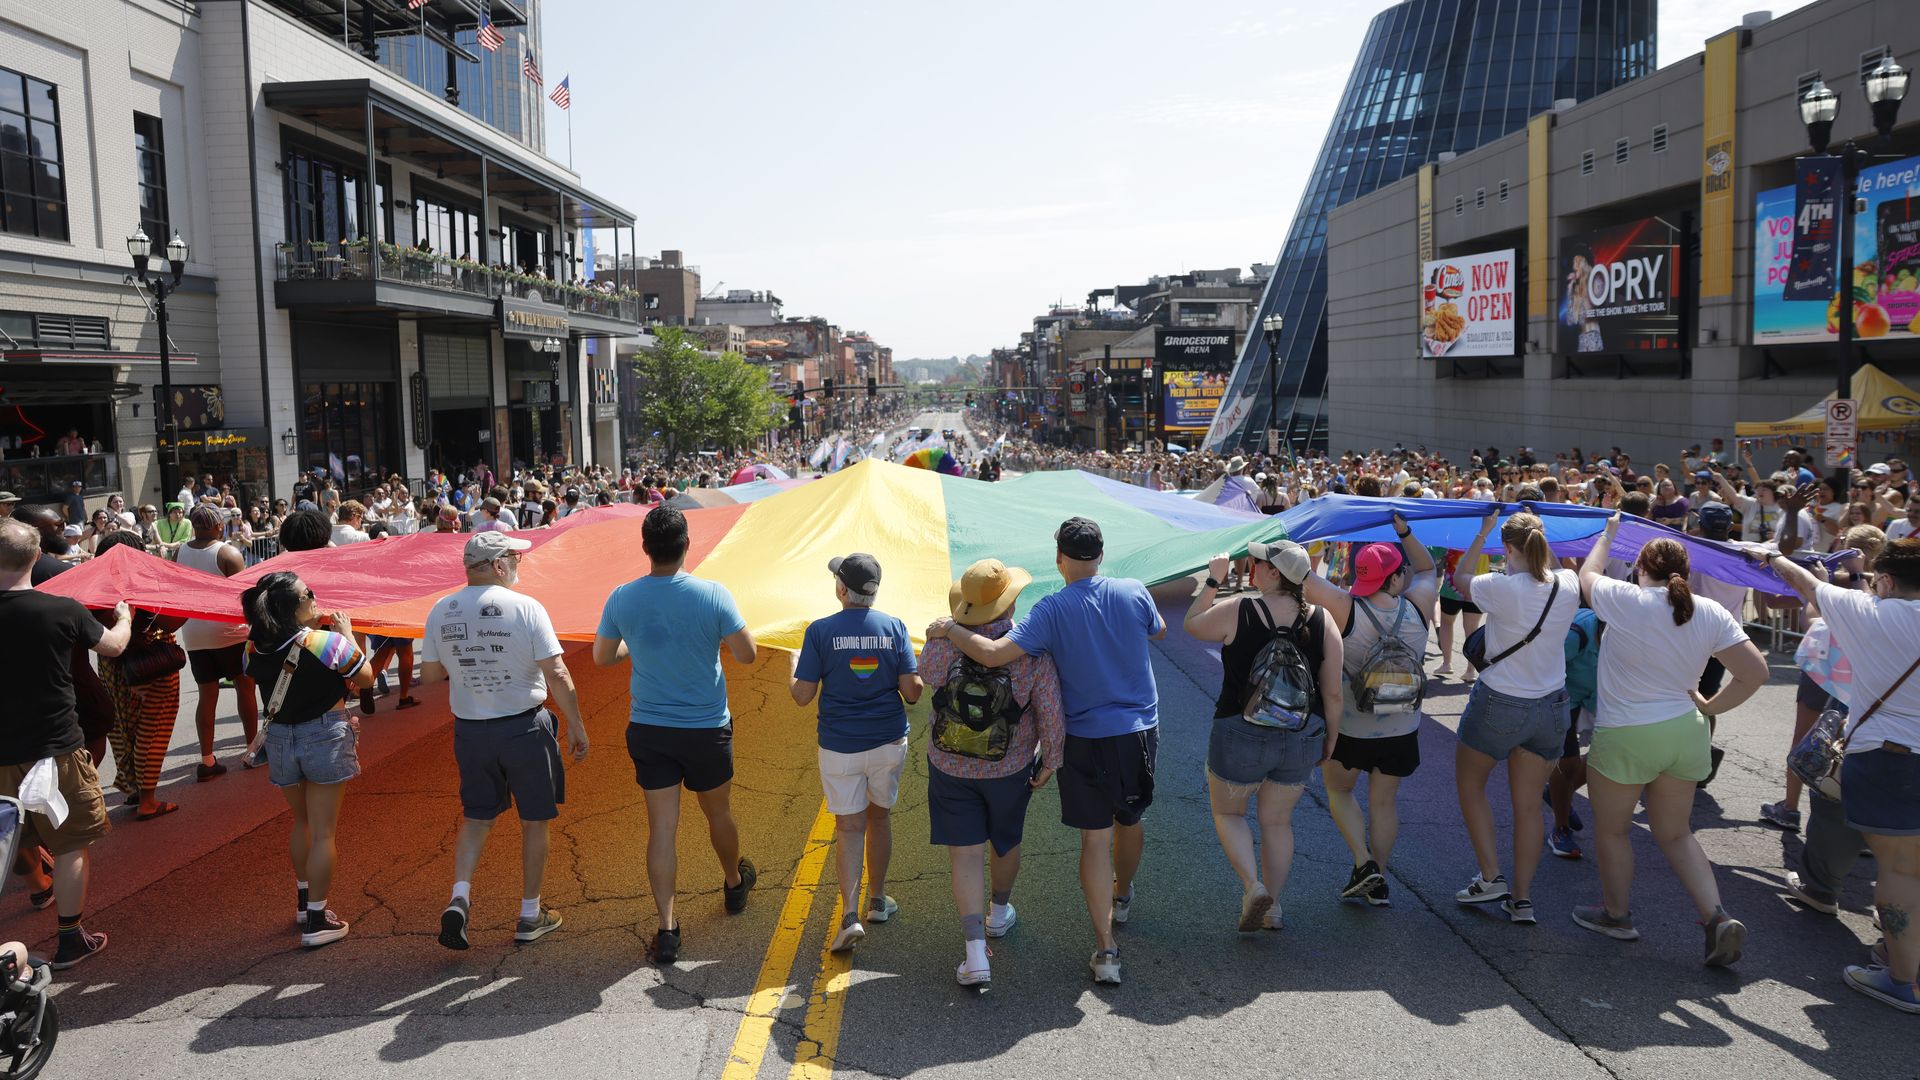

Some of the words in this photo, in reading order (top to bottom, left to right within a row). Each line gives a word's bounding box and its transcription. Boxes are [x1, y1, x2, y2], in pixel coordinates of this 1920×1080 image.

[1876, 166, 1919, 190] here!
[1798, 203, 1833, 235] 4TH
[1471, 261, 1509, 291] NOW
[1588, 254, 1664, 306] OPRY
[1467, 292, 1512, 322] OPEN
[1597, 307, 1606, 316] THE
[1624, 305, 1637, 315] TAKE
[1638, 303, 1648, 313] THE
[1649, 302, 1666, 312] TOUR.
[1164, 336, 1230, 346] BRIDGESTONE
[483, 629, 512, 638] Hardee's
[832, 636, 859, 651] LEADING
[860, 636, 878, 650] WITH
[879, 635, 893, 650] LOVE
[490, 645, 504, 653] TEP
